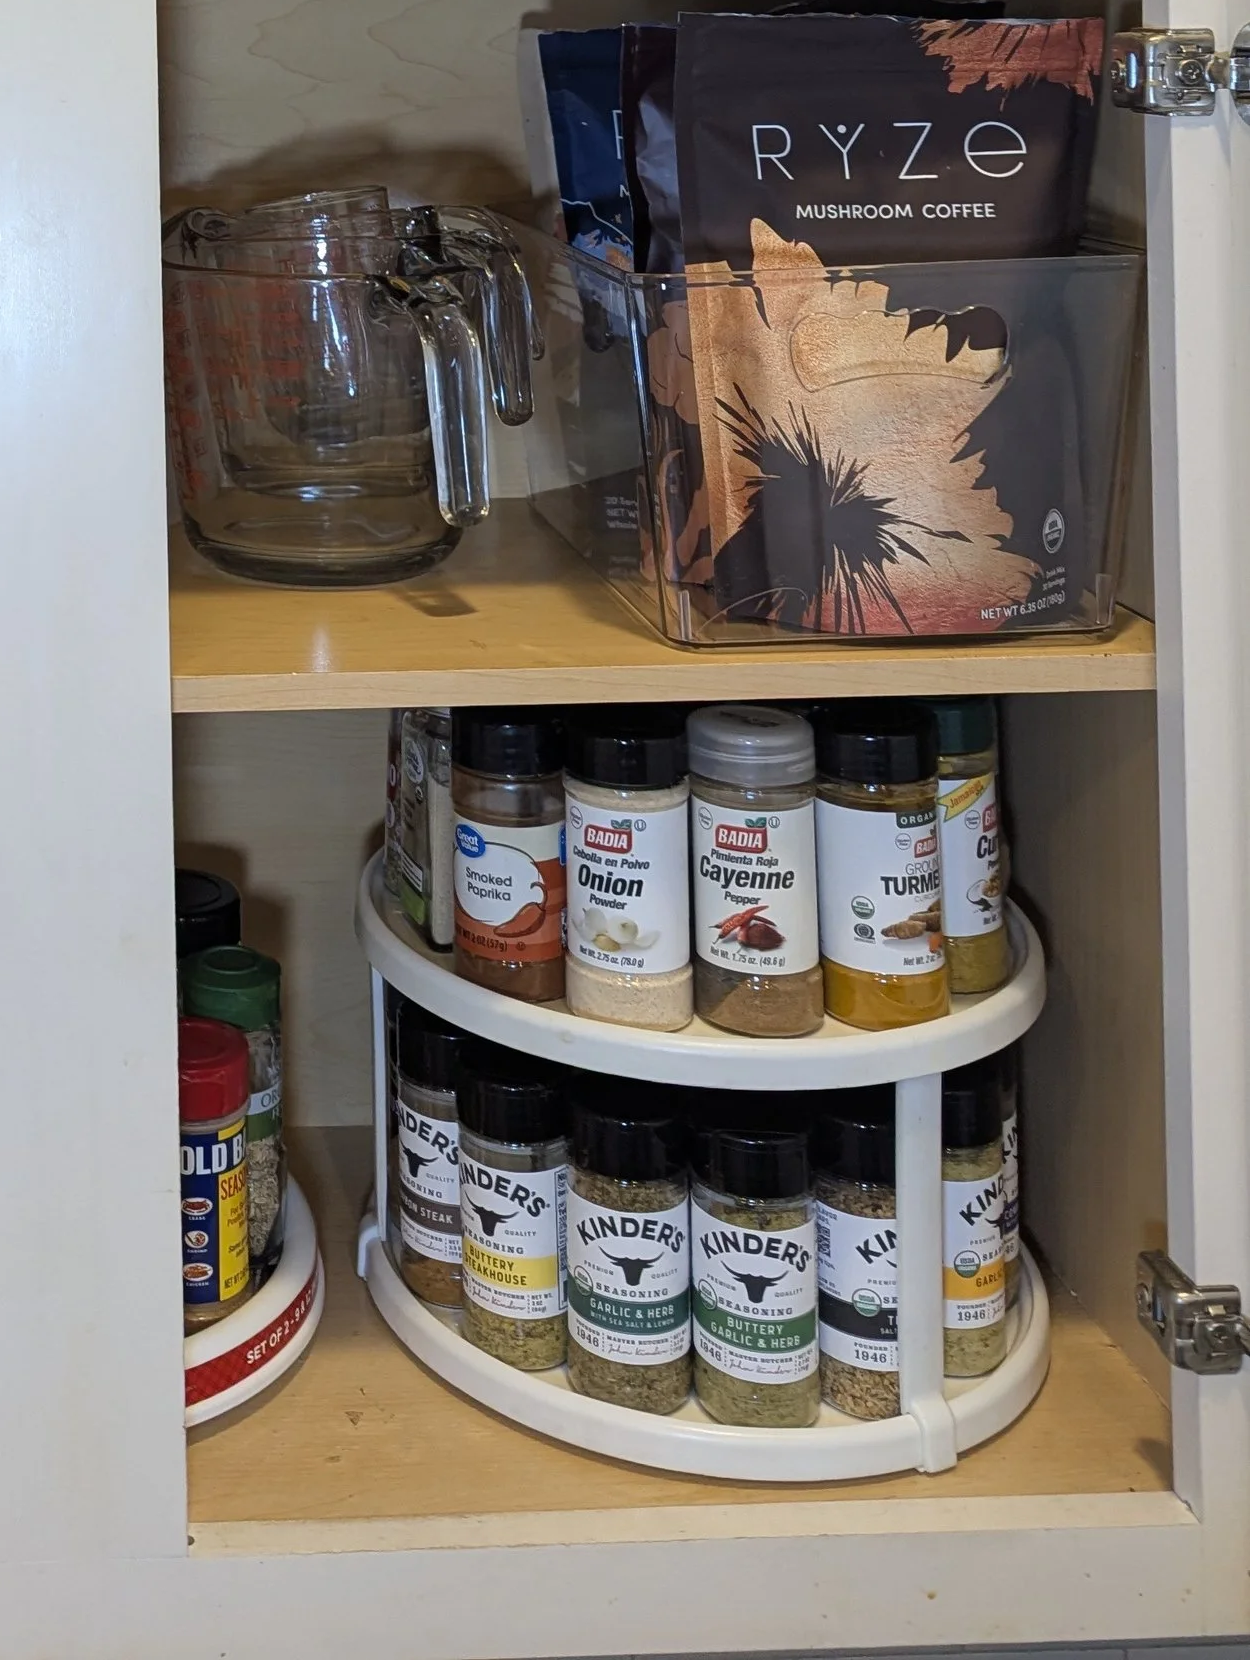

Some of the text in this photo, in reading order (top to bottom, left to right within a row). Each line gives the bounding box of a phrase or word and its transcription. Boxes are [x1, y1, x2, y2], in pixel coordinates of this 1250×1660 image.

[795, 202, 997, 220] MUSHROOM COFFEE
[981, 597, 1047, 620] NET WT 6.35 OZ
[456, 829, 479, 848] Great
[461, 840, 479, 853] Value
[586, 827, 629, 850] BADIA
[717, 828, 763, 849] BADIA
[573, 845, 650, 870] Cebolla en Polvo
[710, 848, 779, 869] Pimienta Roja
[465, 866, 513, 887] Smoked
[578, 863, 644, 898] Onion
[700, 854, 795, 891] Cayenne
[467, 881, 511, 902] Paprika
[589, 893, 628, 910] Powder
[724, 890, 762, 906] Pepper
[486, 936, 508, 952] (57g)
[579, 944, 588, 955] Net
[597, 950, 609, 964] 2.75
[710, 946, 720, 957] Net
[732, 952, 747, 964] 1.75
[759, 955, 778, 968] (49.6
[903, 956, 915, 967] Net
[180, 1142, 228, 1176] OLD
[425, 1171, 455, 1184] QUALITY
[419, 1206, 454, 1224] STEAK
[504, 1229, 537, 1237] QUALITY
[576, 1215, 684, 1254] KINDER'S
[469, 1244, 515, 1272] BUTTERY
[699, 1231, 810, 1273] KINDER'S
[464, 1251, 528, 1286] STEAKHOUSE
[583, 1259, 614, 1276] PREMIUM
[650, 1268, 678, 1280] QUALITY
[595, 1281, 669, 1298] SEASONING
[706, 1273, 737, 1292] PREMIUM
[774, 1287, 804, 1298] QUALITY
[589, 1297, 675, 1319] GARLIC & HERB
[717, 1296, 793, 1317] SEASONING
[956, 1309, 986, 1322] 1946
[590, 1310, 675, 1328] WITH SEA SALT LEMON
[726, 1316, 784, 1336] BUTTERY
[246, 1320, 290, 1364] SET OF 2
[576, 1325, 600, 1348] 1946
[606, 1334, 636, 1345] MASTER
[637, 1336, 669, 1345] BUTCHER
[710, 1321, 801, 1349] GARLIC & HERB
[700, 1338, 722, 1362] 1946
[728, 1349, 793, 1364] MASTER BUTCHER
[854, 1342, 888, 1352] FOUNDED
[854, 1348, 888, 1364] 1946
